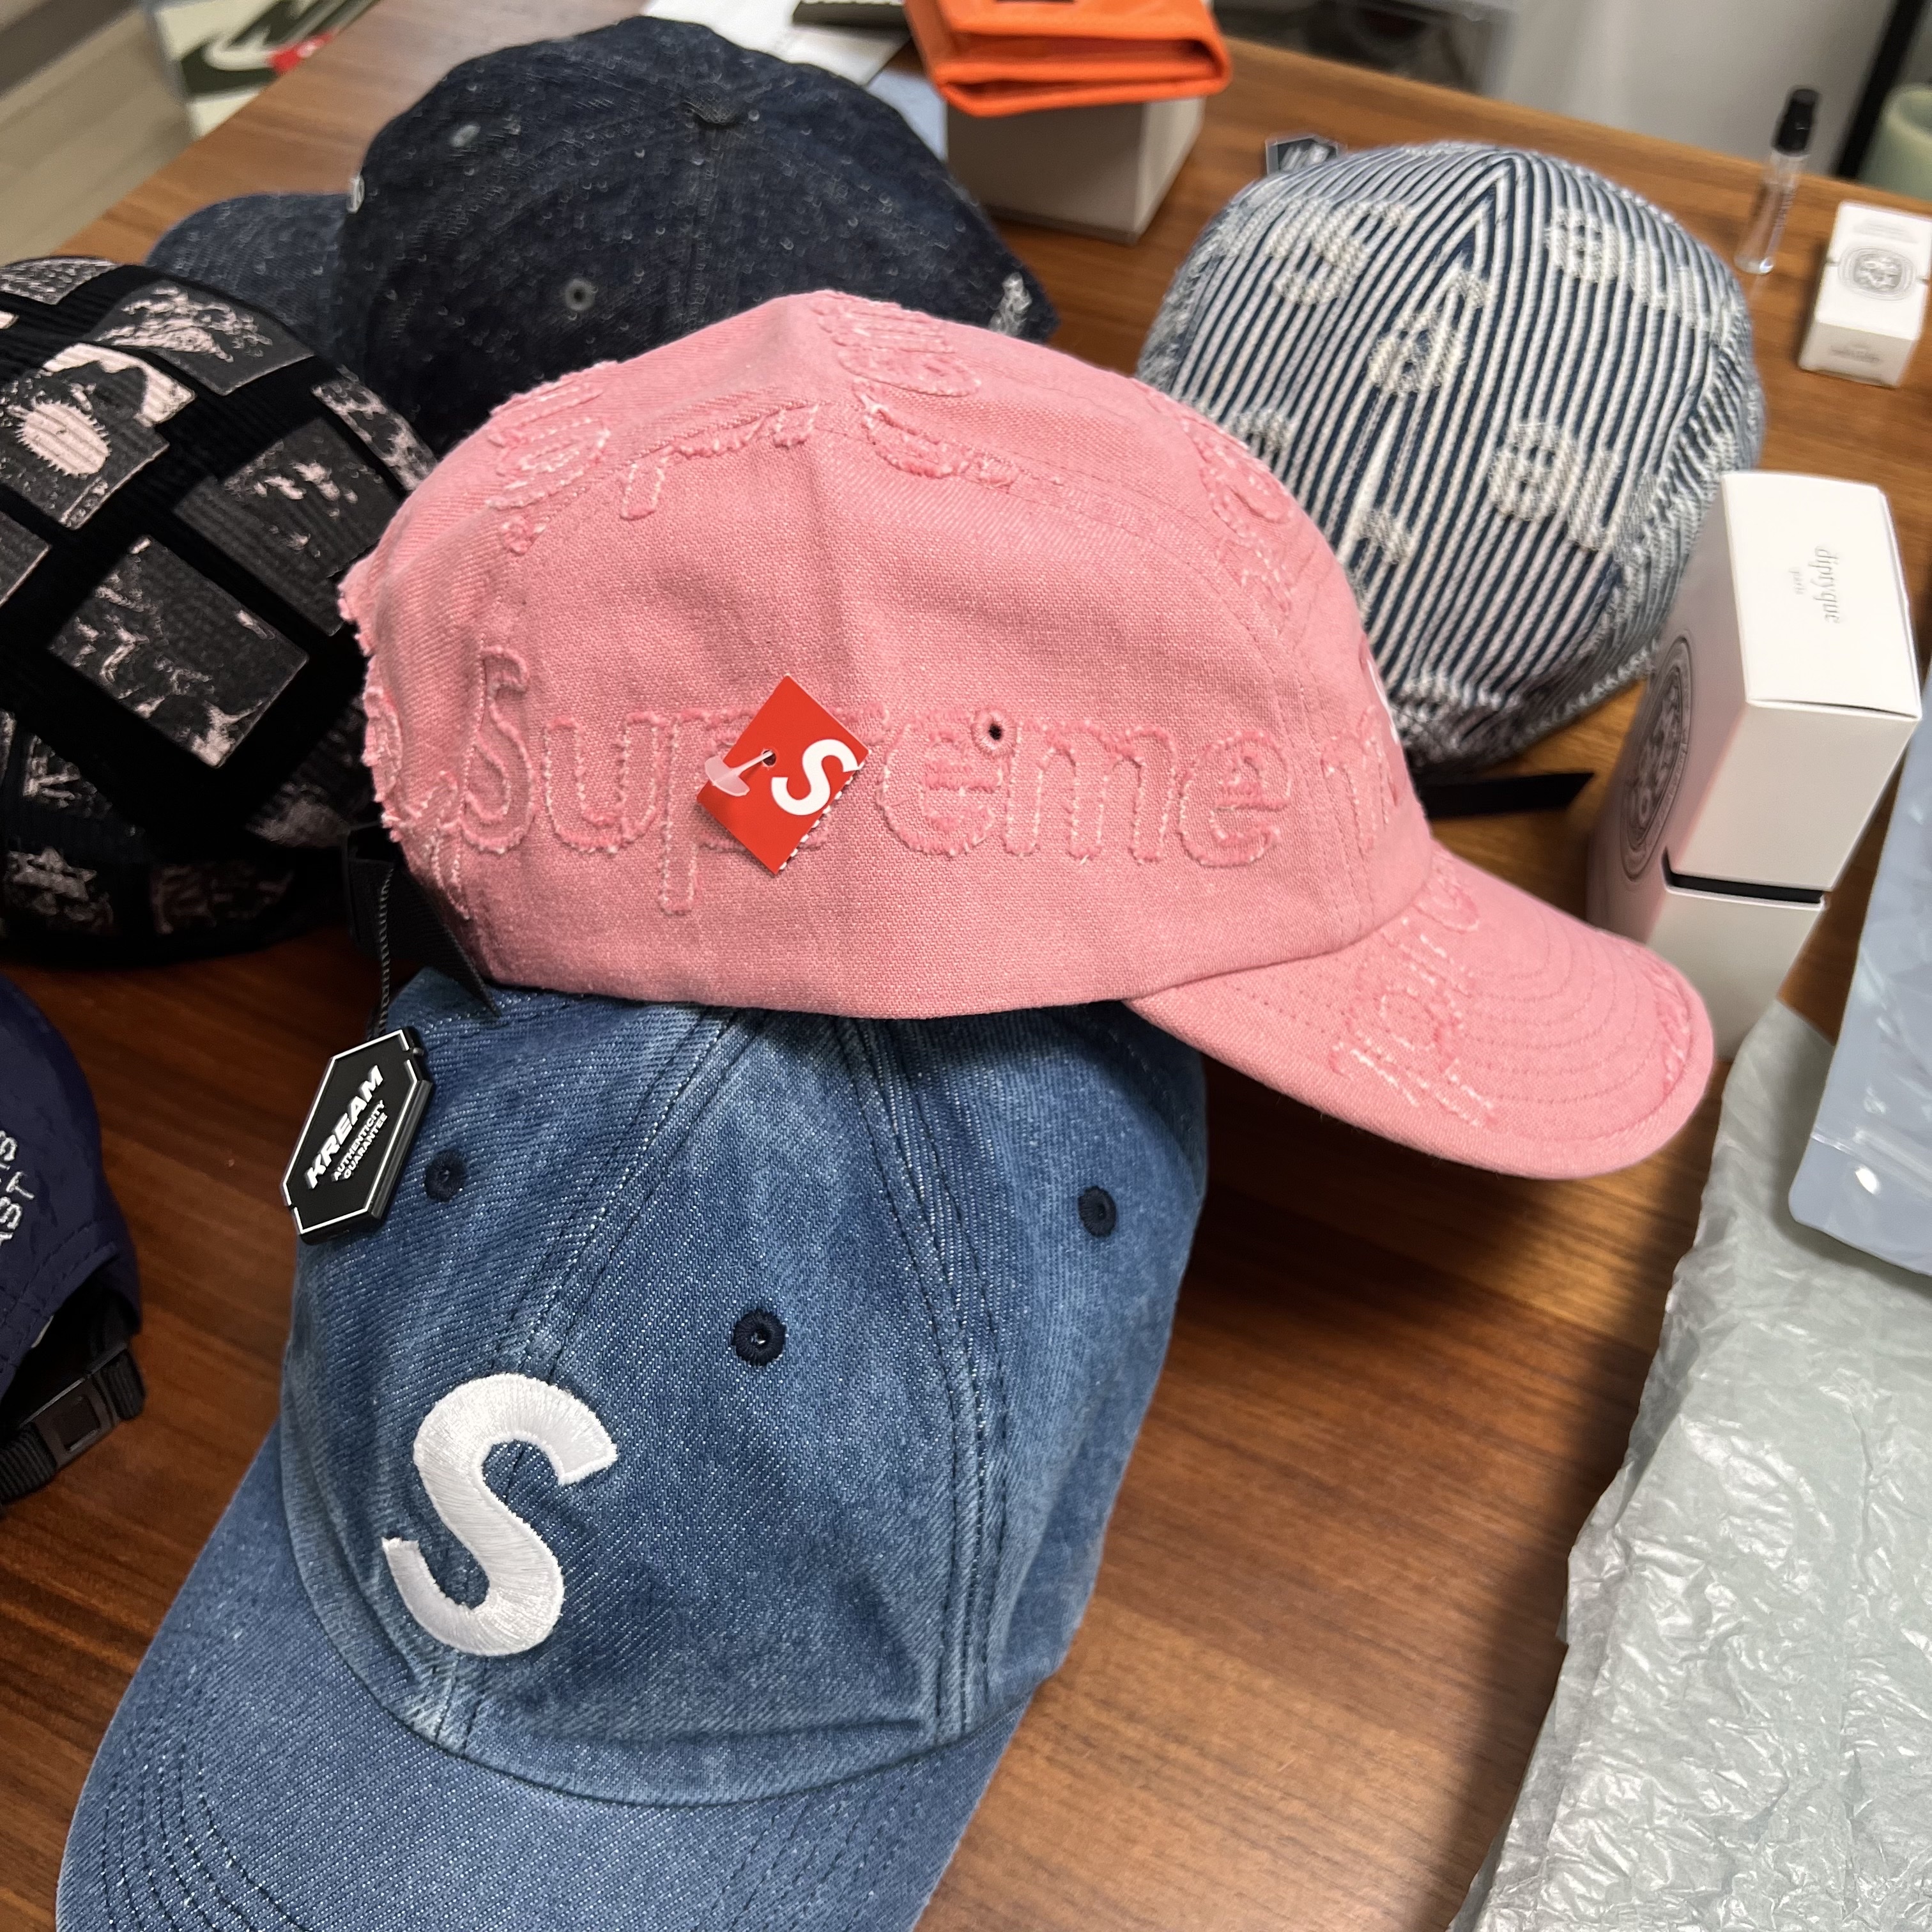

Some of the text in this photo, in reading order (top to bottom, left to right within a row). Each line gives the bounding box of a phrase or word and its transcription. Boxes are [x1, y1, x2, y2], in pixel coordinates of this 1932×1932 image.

[770, 738, 860, 816] S
[304, 1064, 383, 1190] KREAM
[332, 1100, 386, 1182] AUTHENTICITY
[342, 1112, 388, 1181] GUARANTEE
[381, 1372, 618, 1657] S
